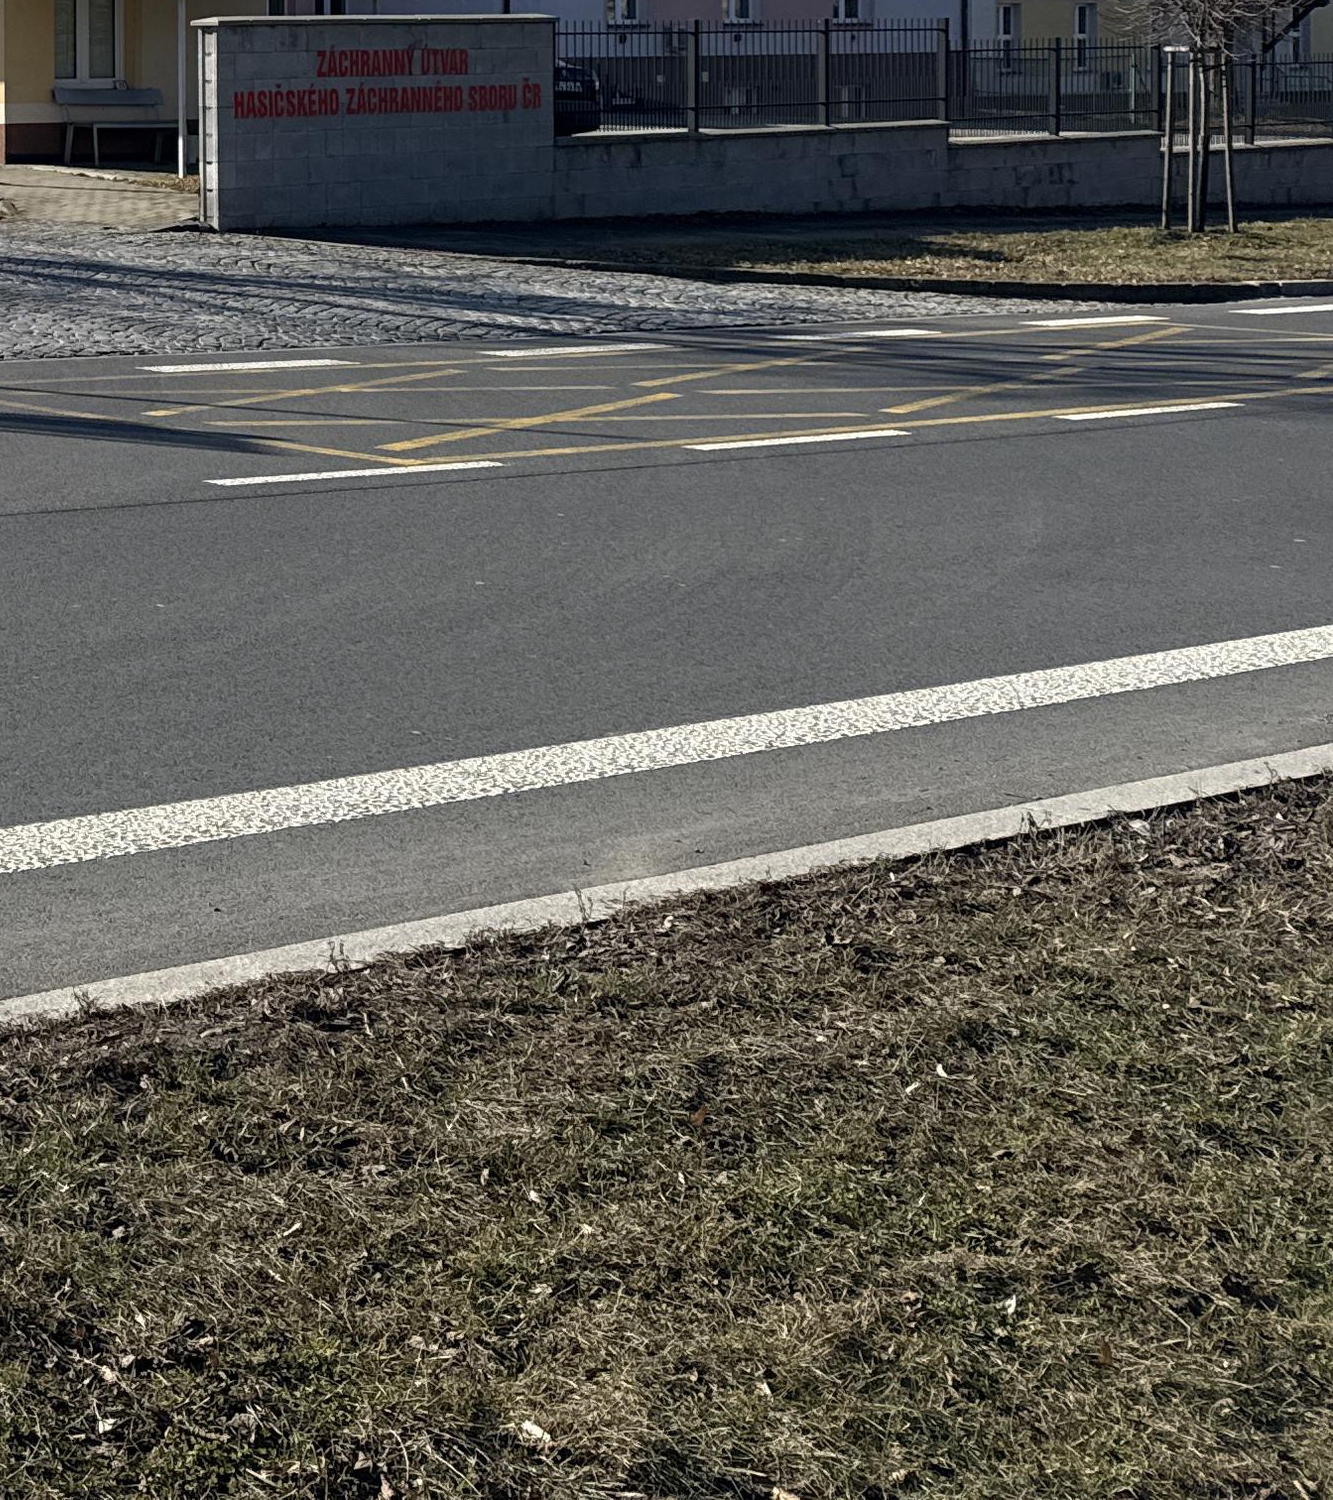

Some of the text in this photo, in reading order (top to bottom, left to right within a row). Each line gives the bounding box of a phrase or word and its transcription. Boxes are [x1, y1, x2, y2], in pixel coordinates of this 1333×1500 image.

[316, 41, 469, 78] ZÁCHRANNÝ ÚTVAR
[233, 77, 542, 119] HASIČSKÉHO ZÁCHRANNÉHO SBORU ČR
